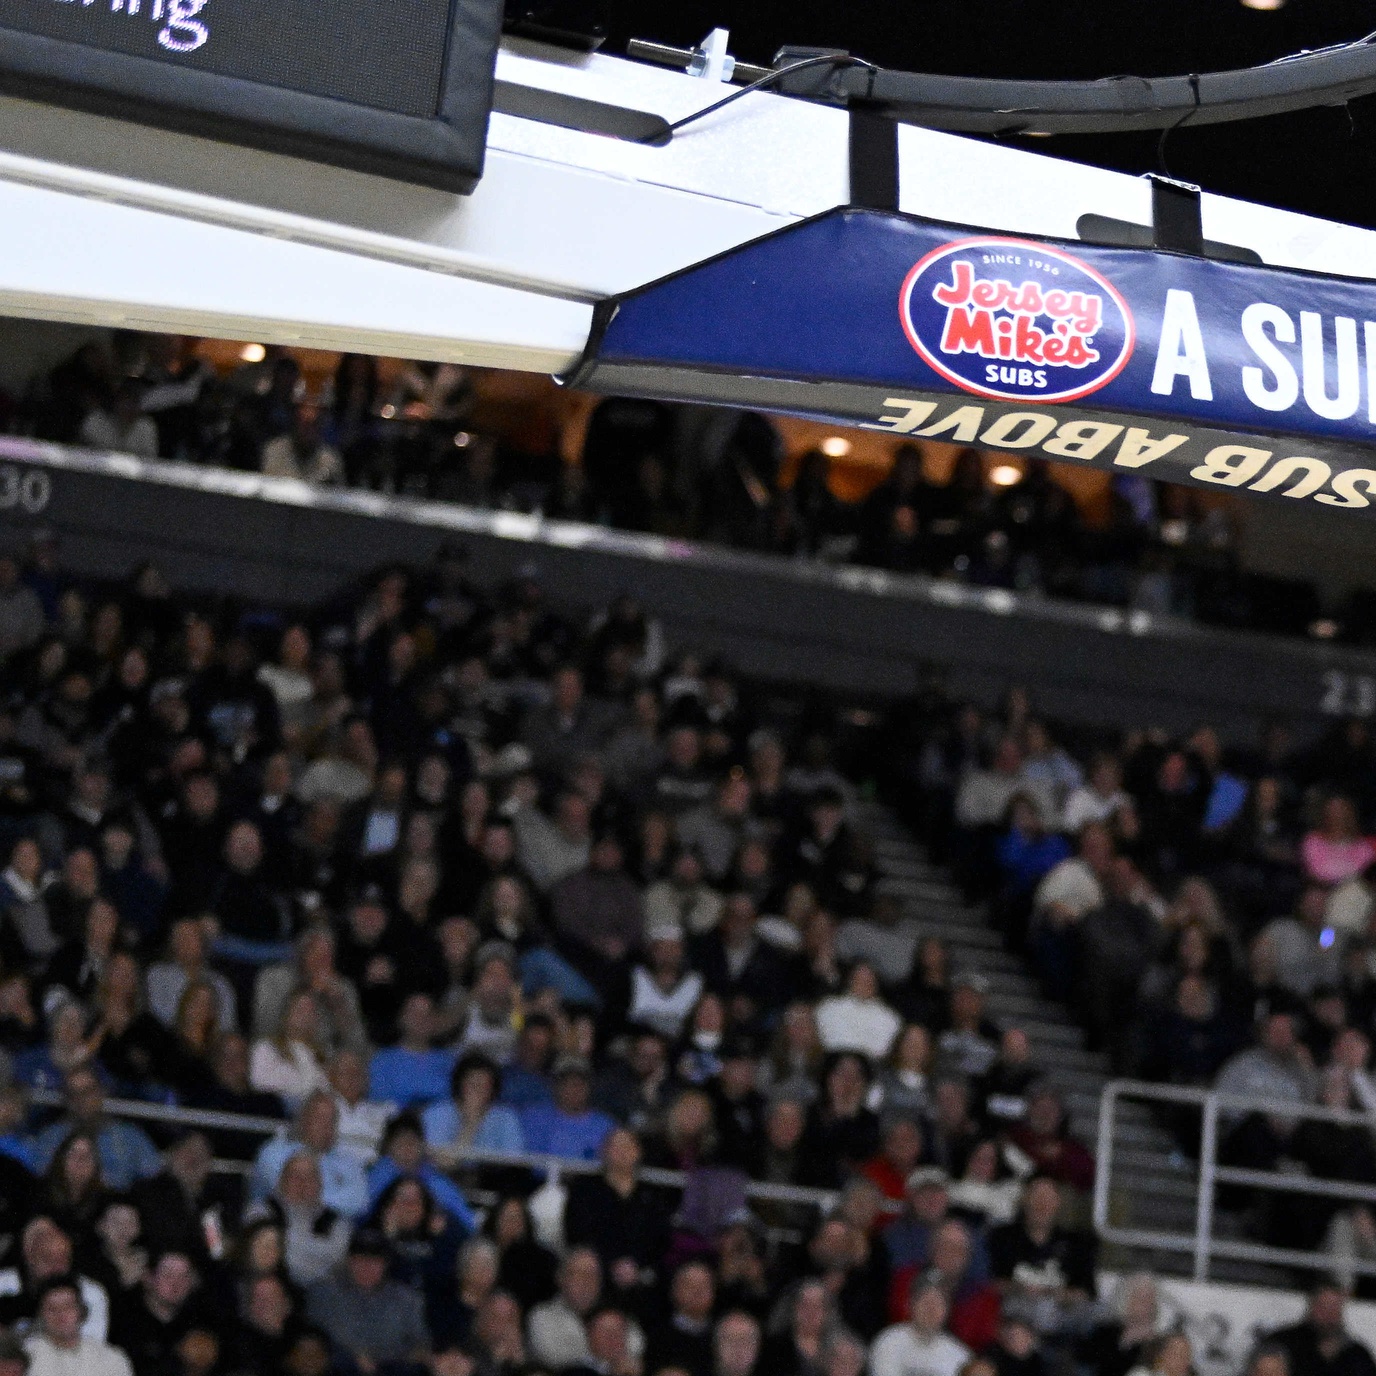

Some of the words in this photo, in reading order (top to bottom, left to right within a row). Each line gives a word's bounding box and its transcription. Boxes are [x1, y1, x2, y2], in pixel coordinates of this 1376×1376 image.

[933, 260, 1103, 335] Jersey
[983, 254, 1021, 265] SINCE
[1028, 258, 1060, 276] 1956
[940, 305, 1100, 369] Mike's
[1151, 290, 1214, 402] A
[985, 364, 1048, 388] SUBS
[859, 397, 1190, 470] ABOVE
